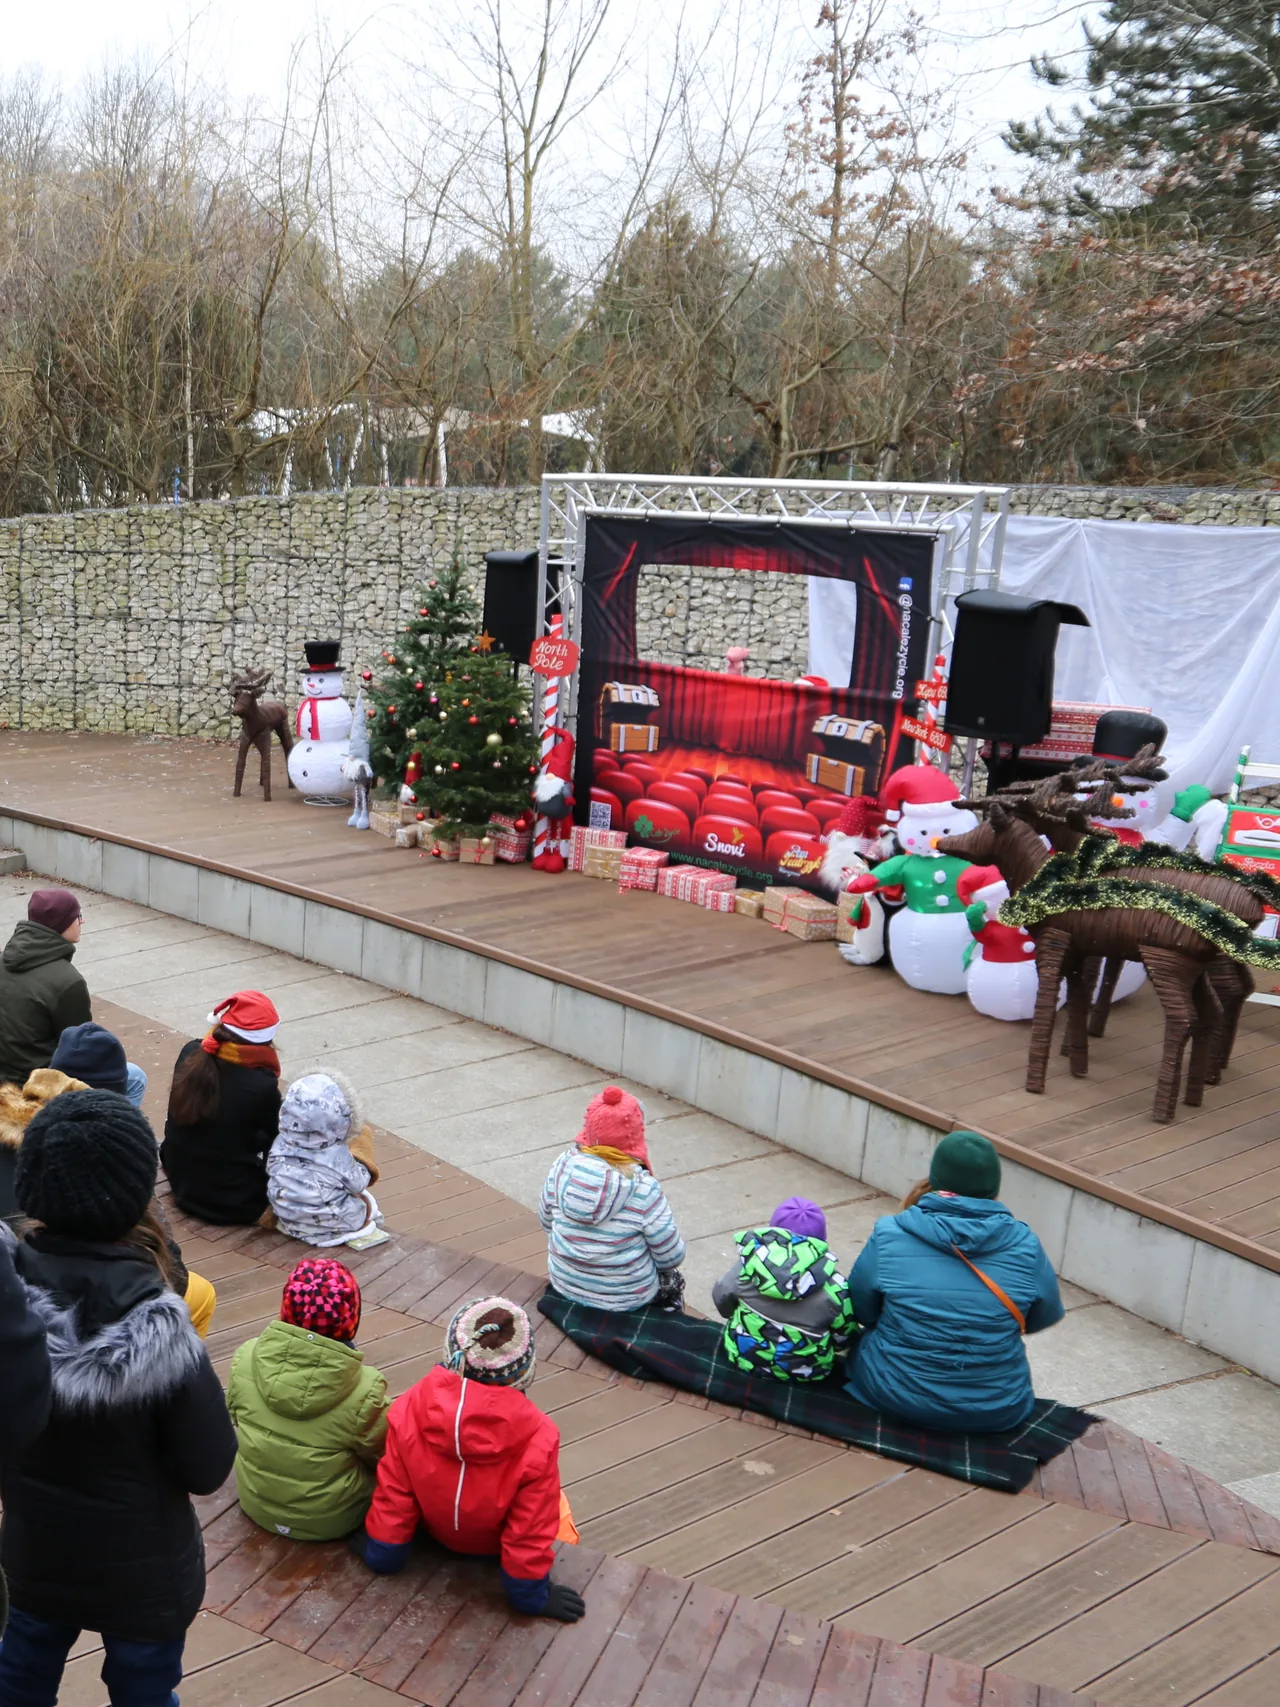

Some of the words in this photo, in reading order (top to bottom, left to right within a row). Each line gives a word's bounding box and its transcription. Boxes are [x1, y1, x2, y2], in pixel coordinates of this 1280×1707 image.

[535, 641, 568, 657] North
[892, 594, 913, 699] @nacalezycie.org
[533, 653, 564, 670] Pole
[704, 832, 745, 857] Snovi
[670, 851, 773, 884] www.nacalezycie.org
